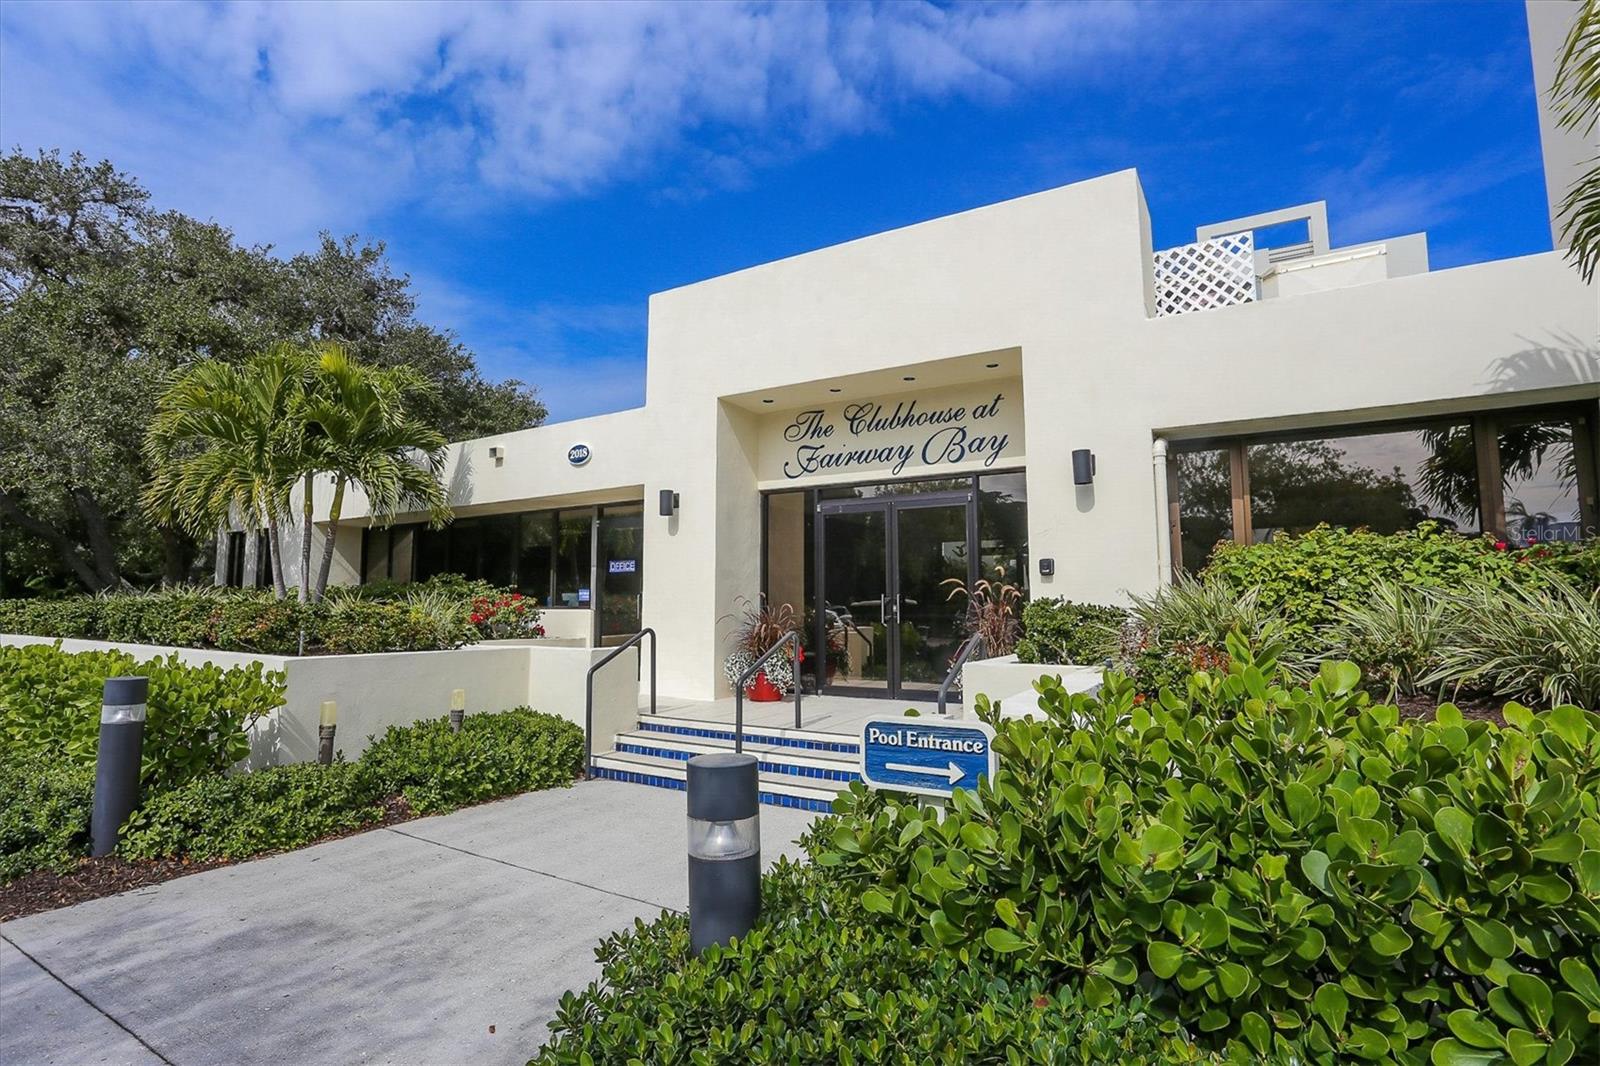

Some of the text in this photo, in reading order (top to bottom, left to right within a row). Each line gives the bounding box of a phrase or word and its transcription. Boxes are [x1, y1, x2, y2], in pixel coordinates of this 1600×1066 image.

[784, 393, 1004, 442] The Clubhouse at
[570, 447, 588, 459] 2018
[784, 425, 1009, 479] Fairway Bay
[609, 561, 635, 572] OFFICE
[869, 728, 985, 754] Pool Entrance
